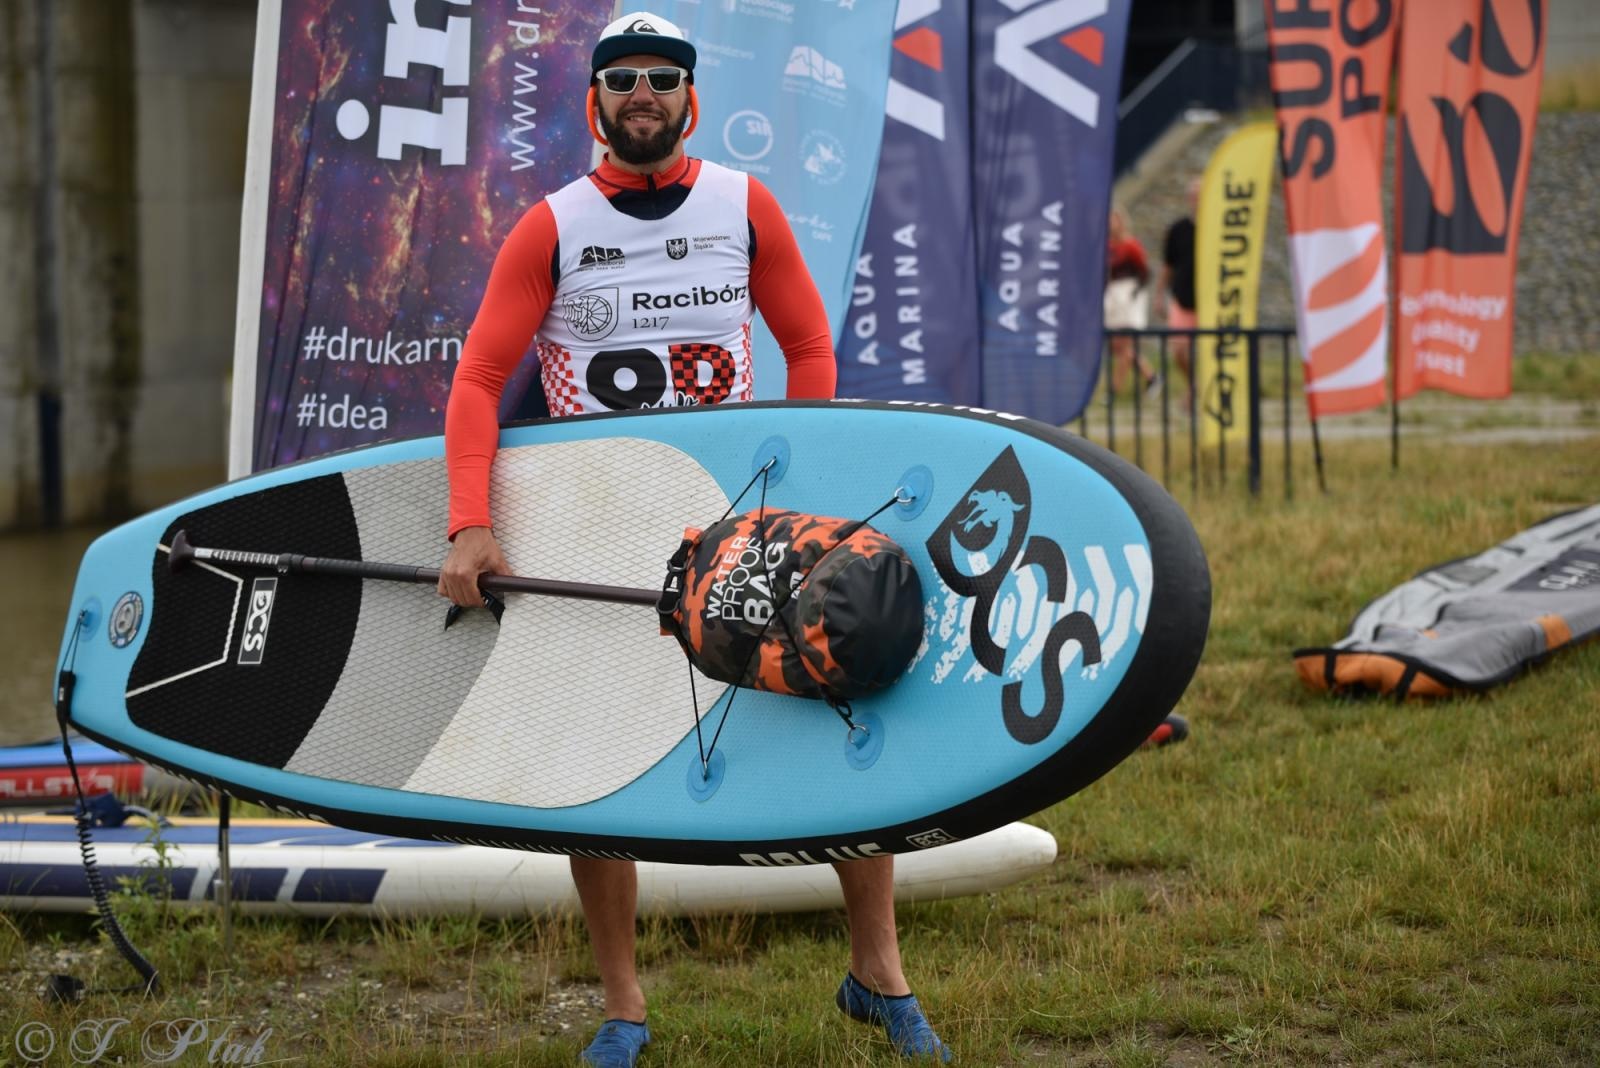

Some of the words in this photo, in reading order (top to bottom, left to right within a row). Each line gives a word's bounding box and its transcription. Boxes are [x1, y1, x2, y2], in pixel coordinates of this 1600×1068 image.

[632, 284, 748, 311] Racibórz
[853, 253, 880, 366] AQUA
[893, 223, 926, 385] MARINA
[998, 222, 1024, 332] AQUA
[1036, 201, 1063, 356] MARINA
[304, 326, 469, 365] #drukarn
[632, 316, 670, 330] 1217
[297, 393, 388, 430] #idea
[706, 536, 750, 619] WATER
[721, 537, 762, 620] PROOF
[743, 542, 788, 627] BAG
